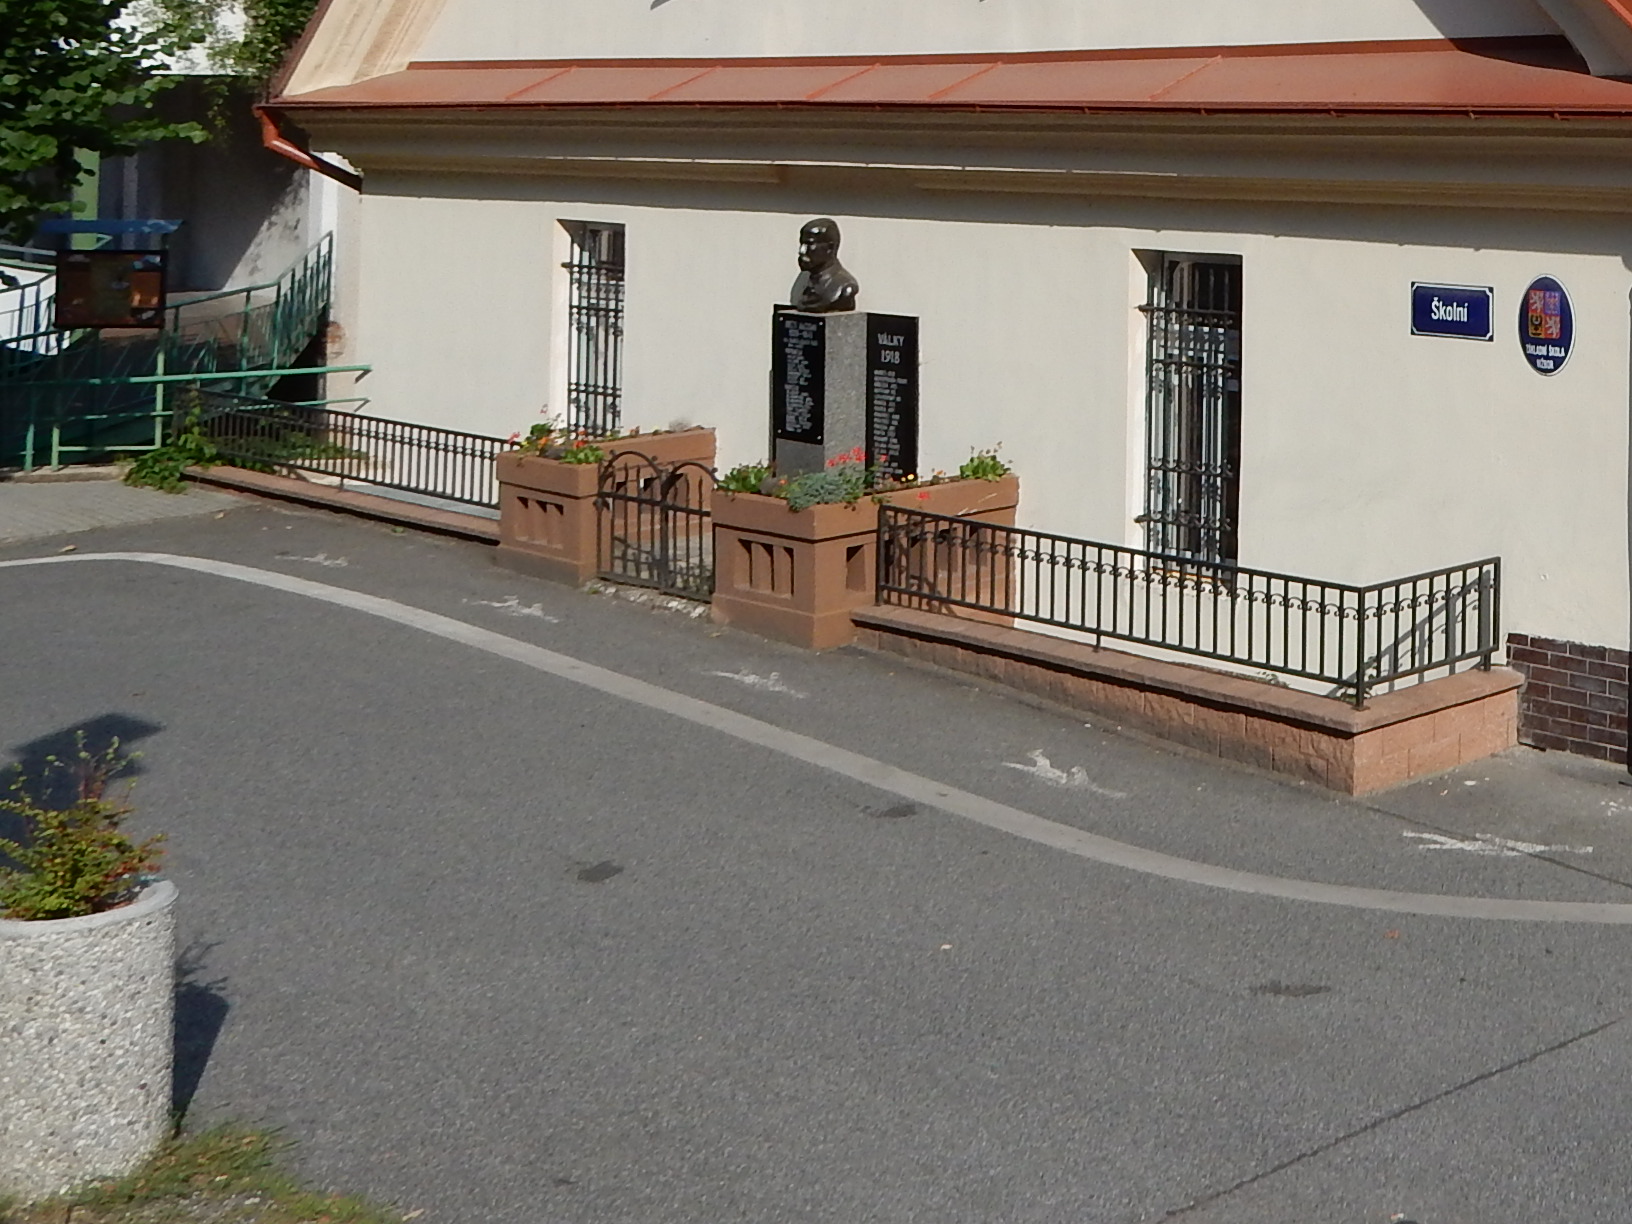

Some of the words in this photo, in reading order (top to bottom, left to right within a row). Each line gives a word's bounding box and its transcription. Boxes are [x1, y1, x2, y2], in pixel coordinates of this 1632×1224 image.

[1431, 297, 1468, 322] Školní
[878, 332, 904, 347] VÁLKY
[881, 349, 900, 364] 1918
[1549, 344, 1565, 357] ŠKOLA
